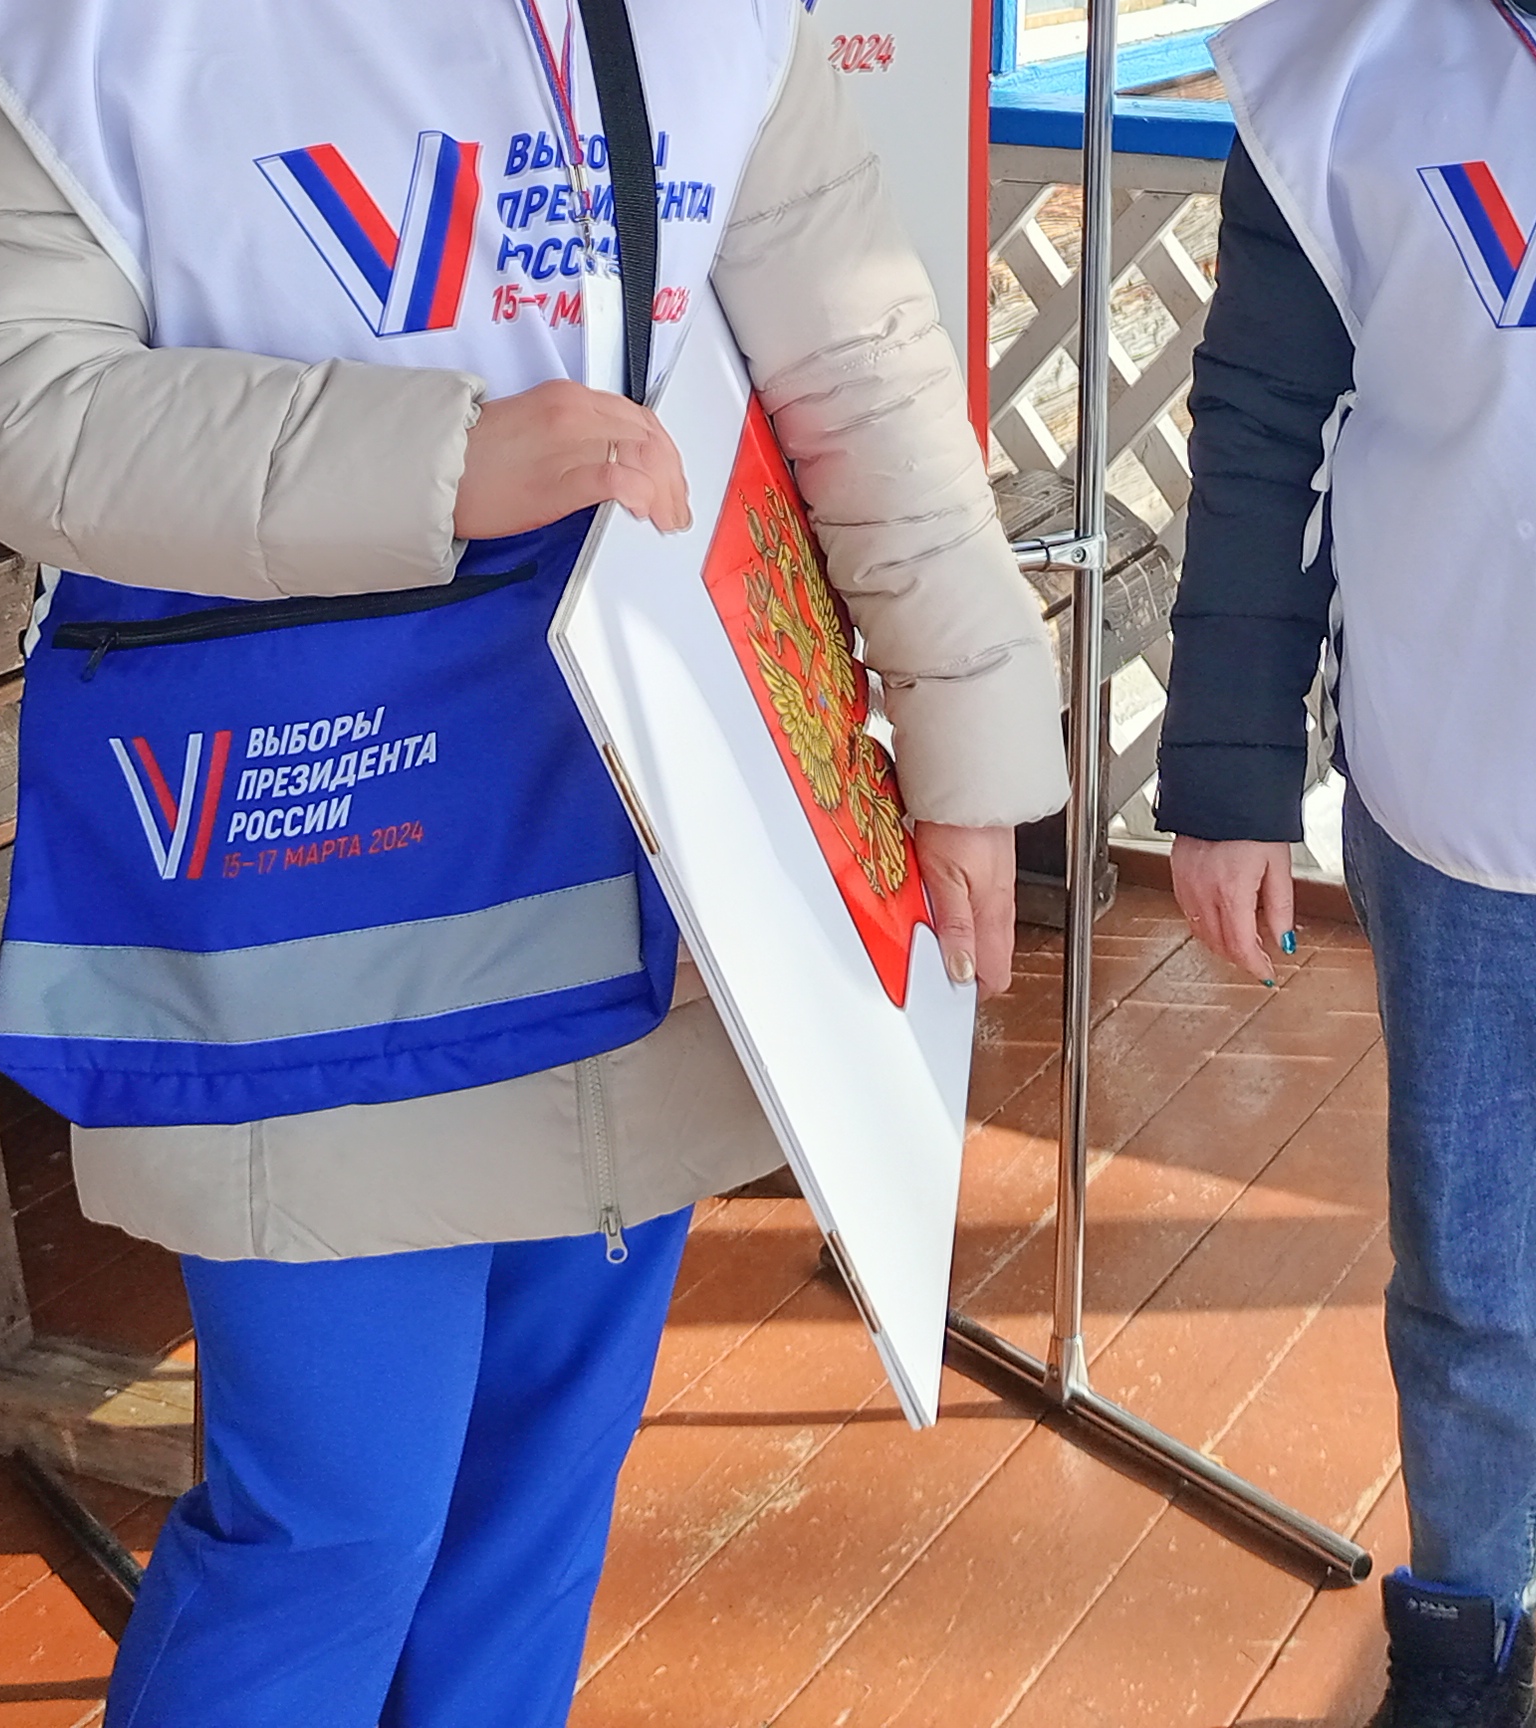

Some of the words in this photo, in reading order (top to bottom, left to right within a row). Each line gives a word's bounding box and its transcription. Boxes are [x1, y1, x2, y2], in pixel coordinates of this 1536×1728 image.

[827, 34, 894, 71] 2024
[246, 705, 386, 759] ВЫБОРЫ
[236, 731, 437, 801] ПРЕЗИДЕНТА
[226, 793, 353, 843] РОССИИ
[283, 834, 362, 871] МАРТА
[367, 820, 425, 854] 2024
